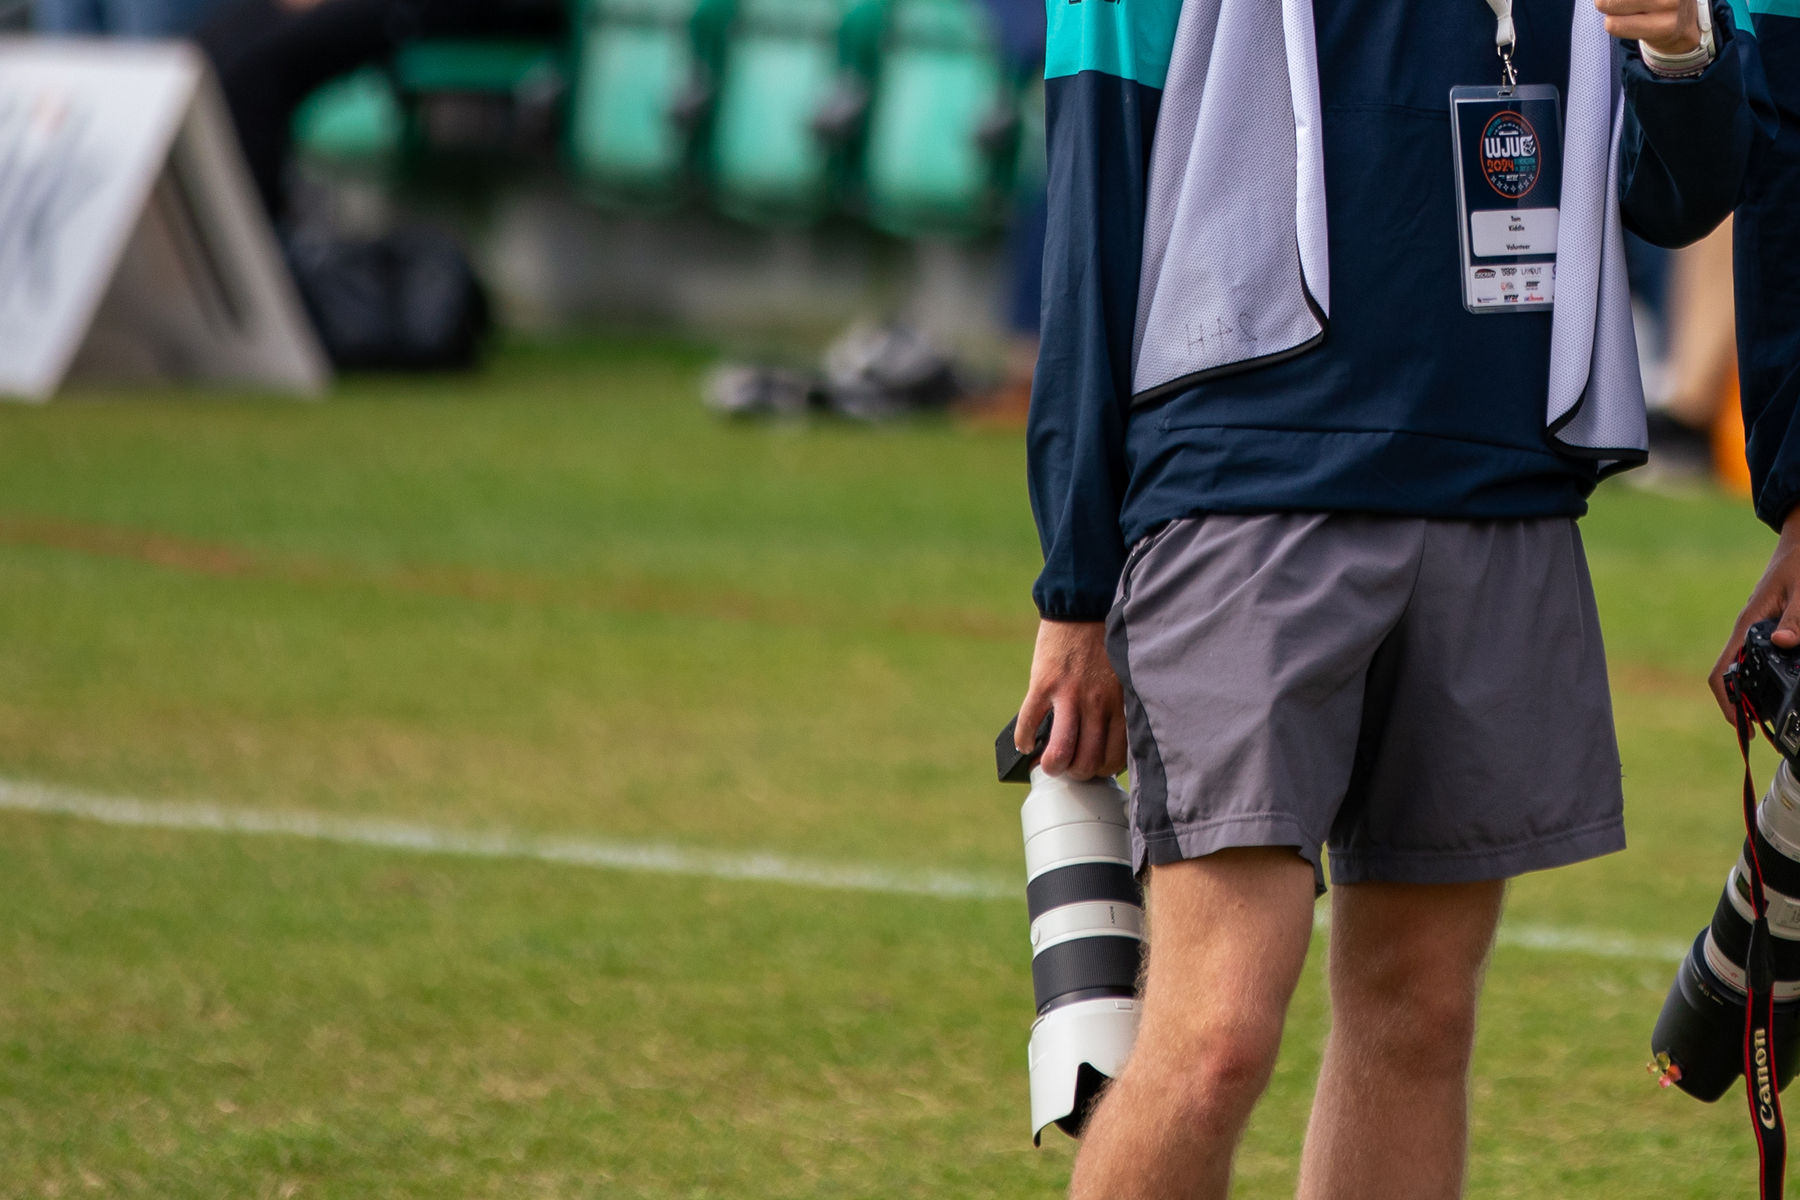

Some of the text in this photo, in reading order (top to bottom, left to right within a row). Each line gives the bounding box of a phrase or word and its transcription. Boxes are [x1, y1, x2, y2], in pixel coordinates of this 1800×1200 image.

[1484, 135, 1536, 158] WJUE
[1487, 158, 1514, 174] 2024
[1753, 1027, 1777, 1131] Canon
